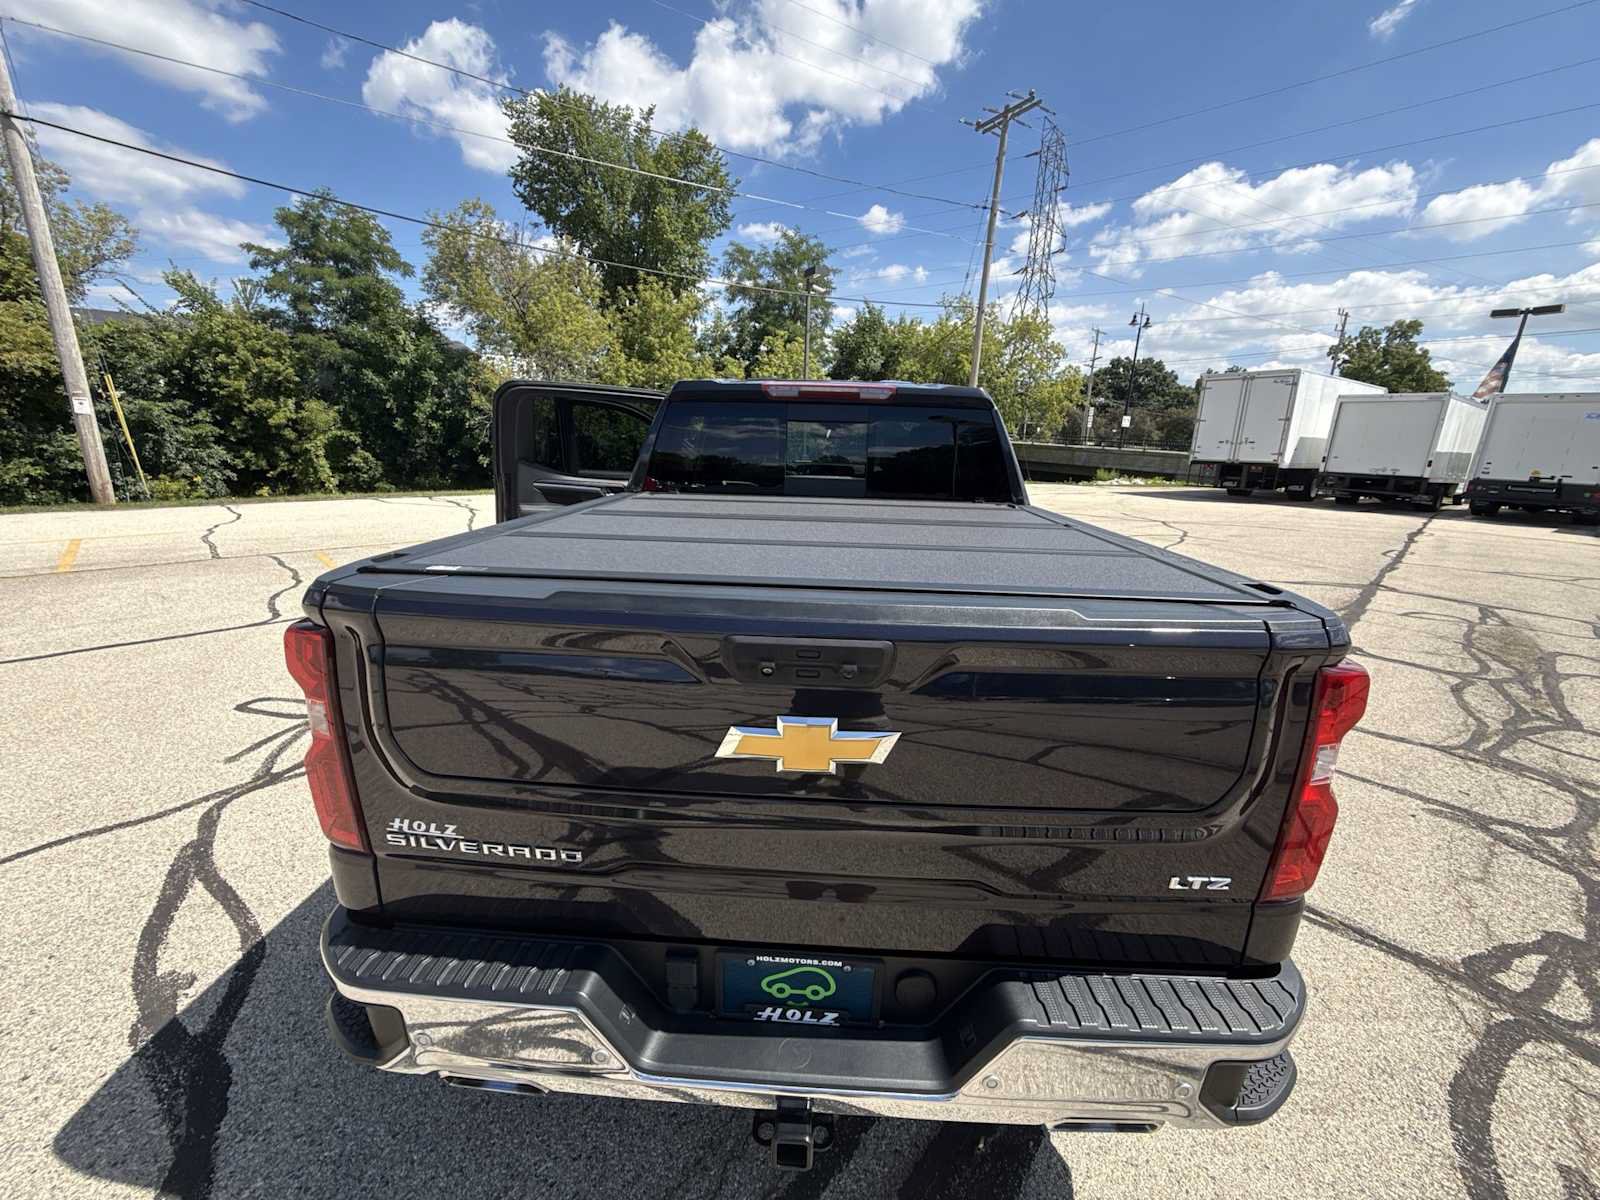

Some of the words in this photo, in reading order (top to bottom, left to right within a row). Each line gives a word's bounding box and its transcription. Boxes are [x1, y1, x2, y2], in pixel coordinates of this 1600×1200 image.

[387, 817, 461, 837] HOLZ
[386, 833, 583, 863] SILVERADO
[1168, 876, 1232, 890] LTZ
[756, 955, 843, 967] HOLZMOTORS.COM
[755, 1006, 840, 1026] HOLZ
